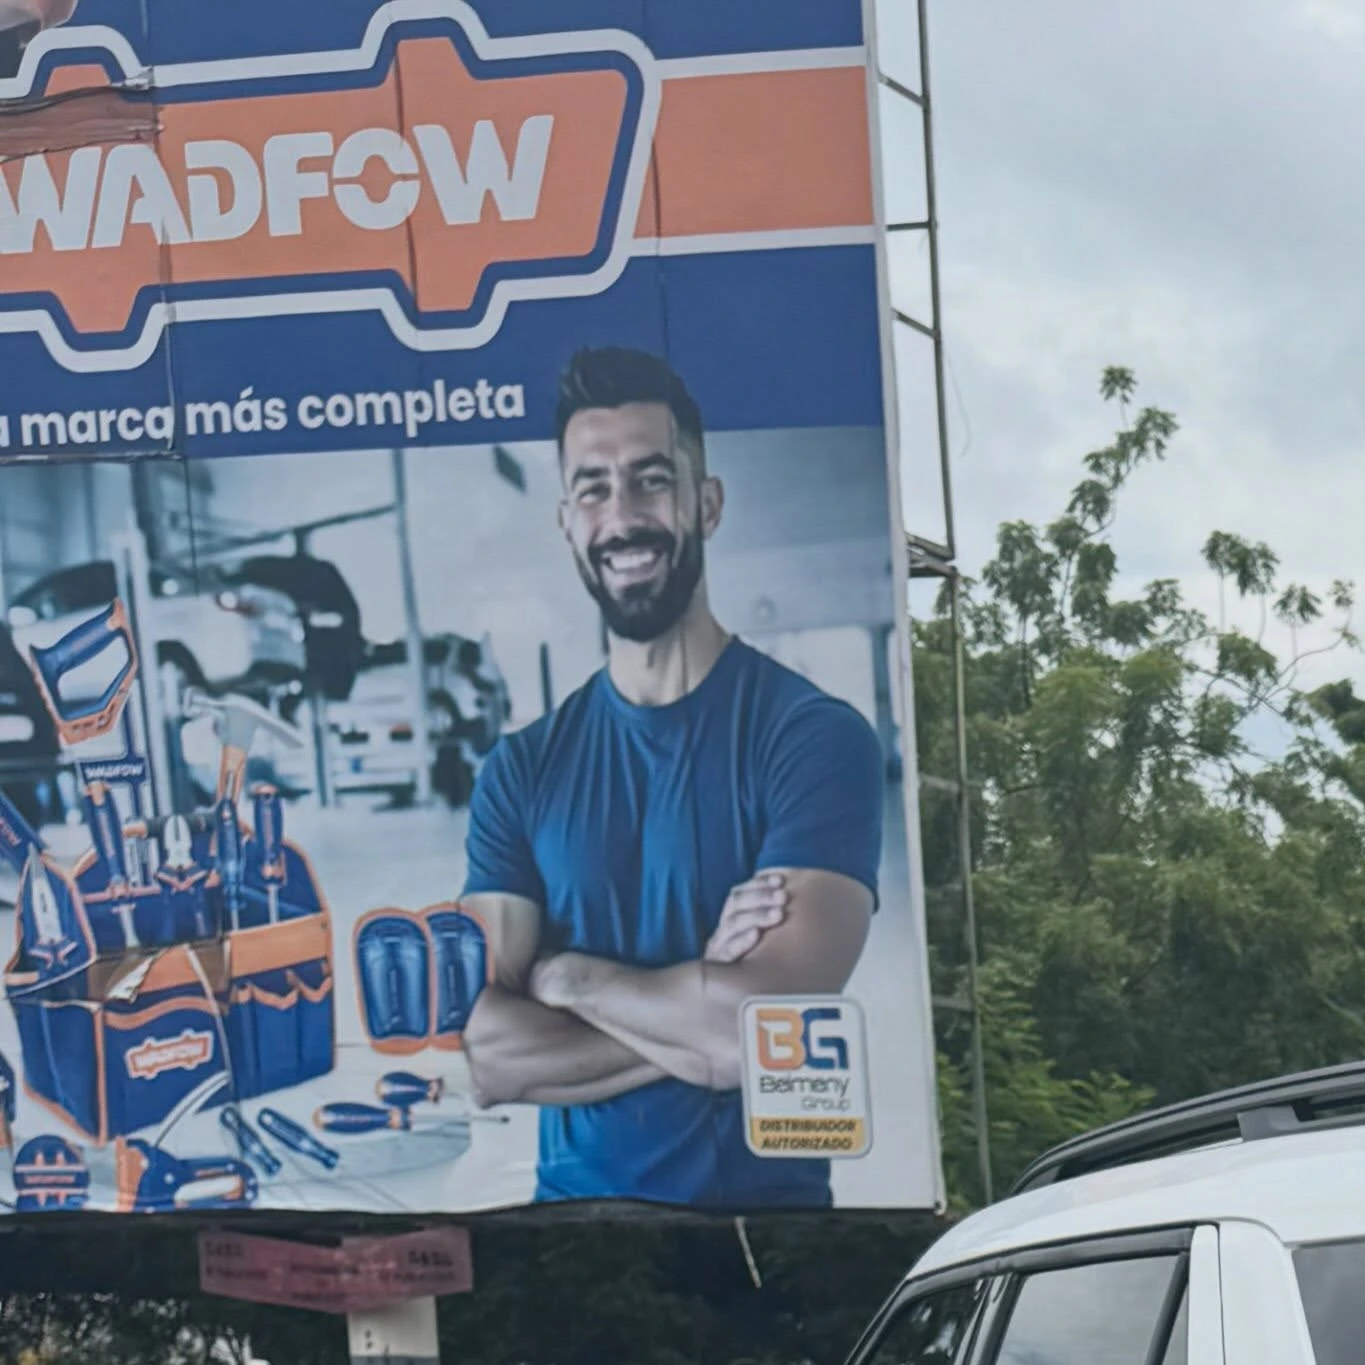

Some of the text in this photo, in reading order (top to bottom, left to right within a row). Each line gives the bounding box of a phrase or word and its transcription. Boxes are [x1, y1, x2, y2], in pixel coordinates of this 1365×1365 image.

[0, 115, 555, 254] WADFOW
[20, 405, 174, 447] marca
[185, 386, 288, 435] más
[298, 379, 526, 438] completa
[756, 1008, 849, 1071] BG
[759, 1119, 856, 1133] DISTRIBUIDOR
[761, 1136, 853, 1150] AUTORIZADO
